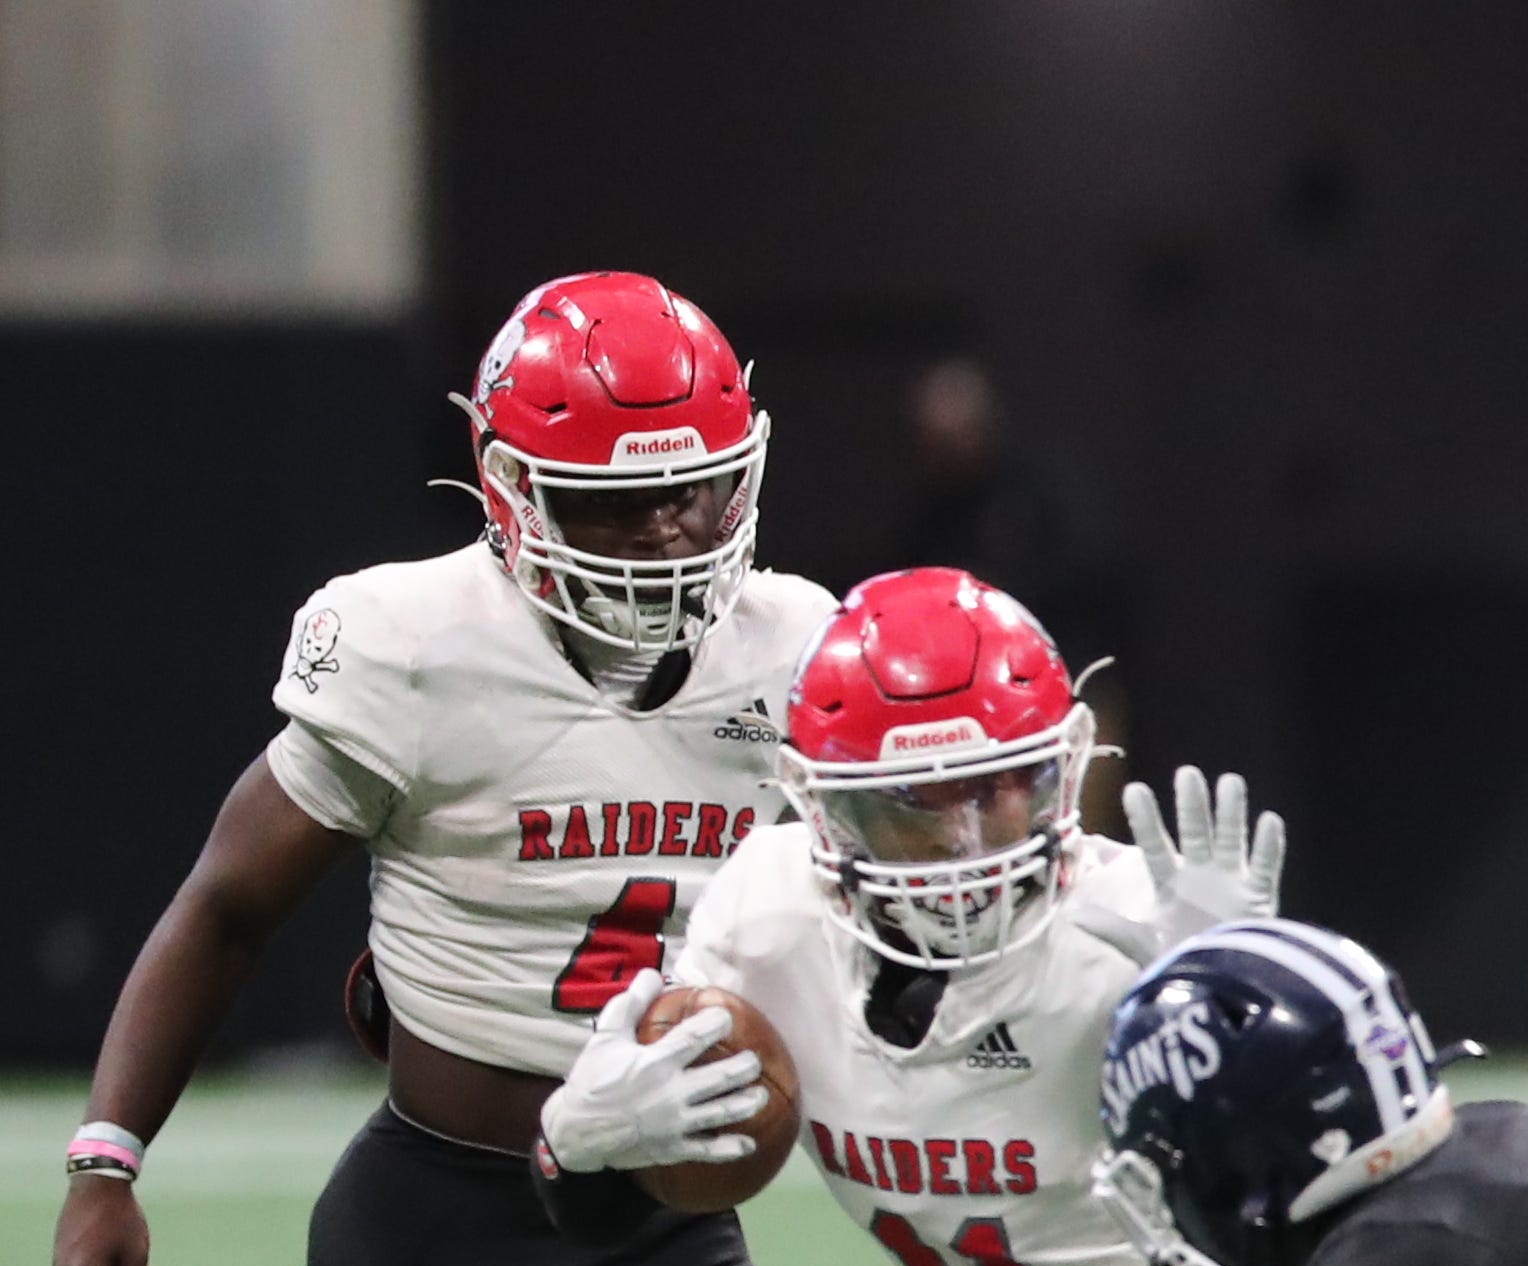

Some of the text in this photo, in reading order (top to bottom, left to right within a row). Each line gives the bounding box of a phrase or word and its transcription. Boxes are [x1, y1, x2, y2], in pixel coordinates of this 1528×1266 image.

[626, 436, 695, 455] Riddell
[714, 724, 779, 743] adidas
[894, 726, 971, 752] Riddell
[518, 801, 756, 861] RAIDERS
[552, 875, 677, 1015] 4
[967, 1052, 1031, 1069] adidas
[808, 1119, 1038, 1196] RAIDERS
